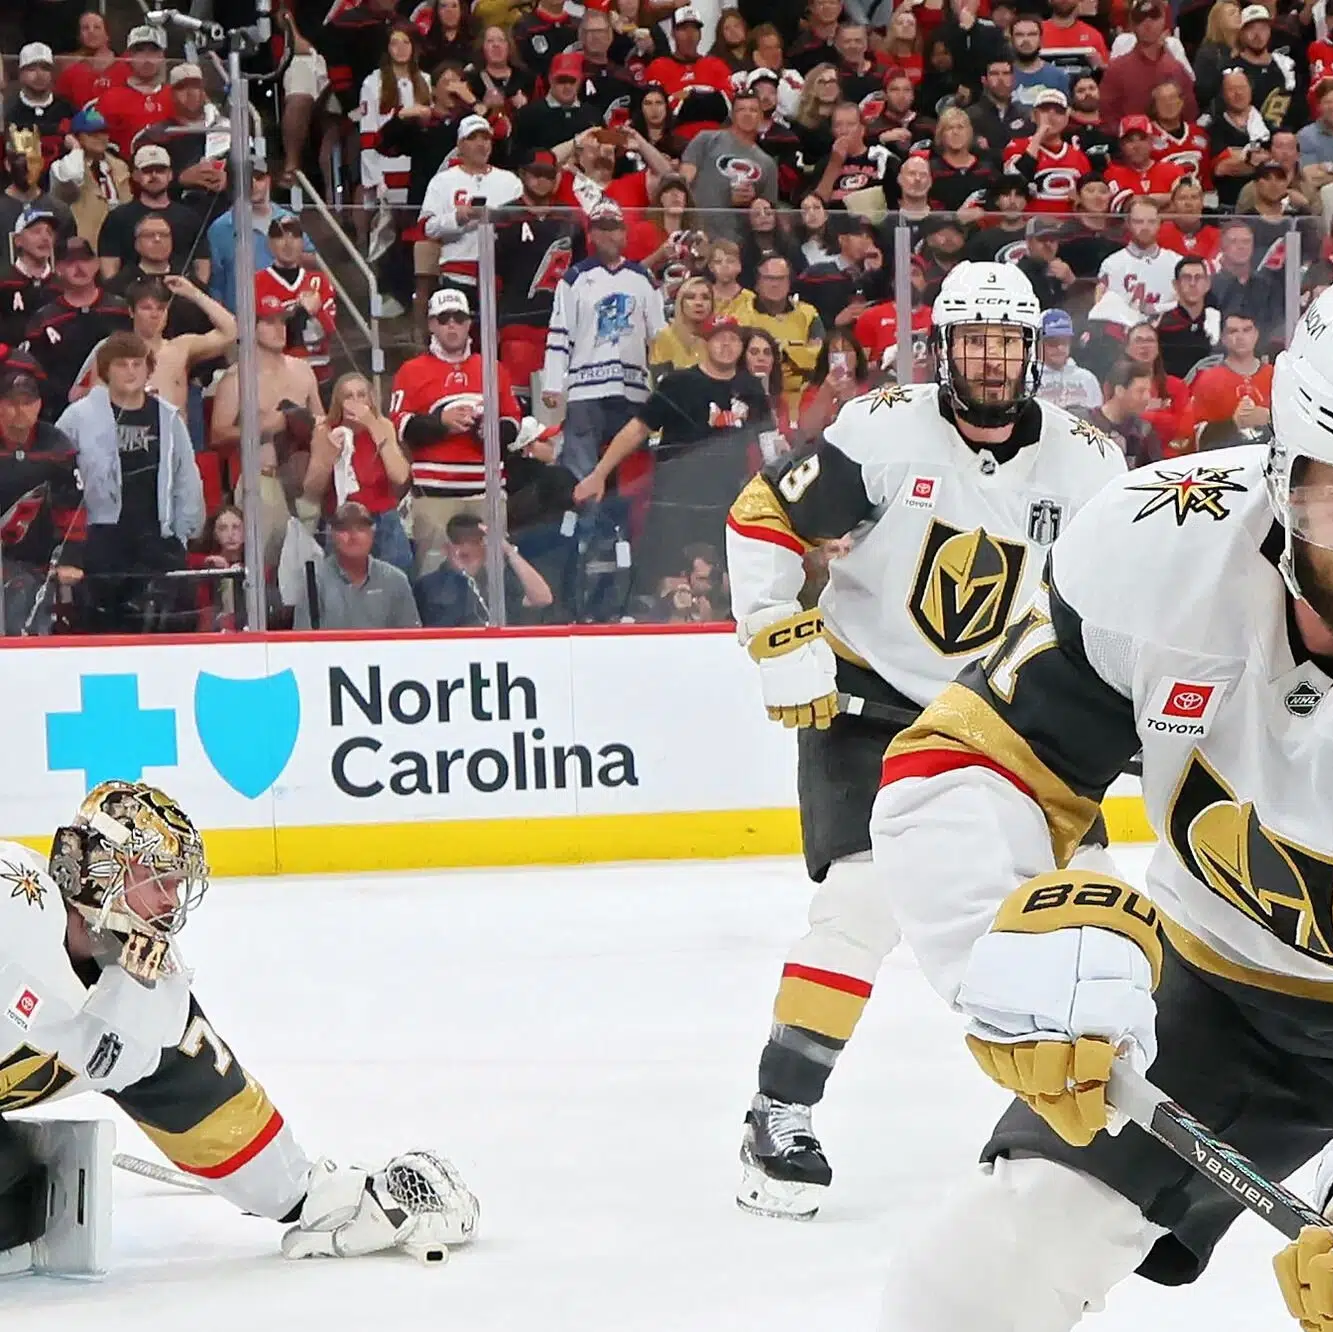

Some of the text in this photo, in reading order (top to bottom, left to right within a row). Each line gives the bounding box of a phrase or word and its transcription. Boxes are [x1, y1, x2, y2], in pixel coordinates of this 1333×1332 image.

[905, 498, 934, 509] TOYOTA
[329, 662, 538, 726] North
[1147, 718, 1205, 736] TOYOTA
[331, 728, 640, 799] Carolina
[6, 1009, 29, 1031] TOYOTA
[177, 1015, 234, 1077] 7
[1204, 1158, 1275, 1216] BAUER
